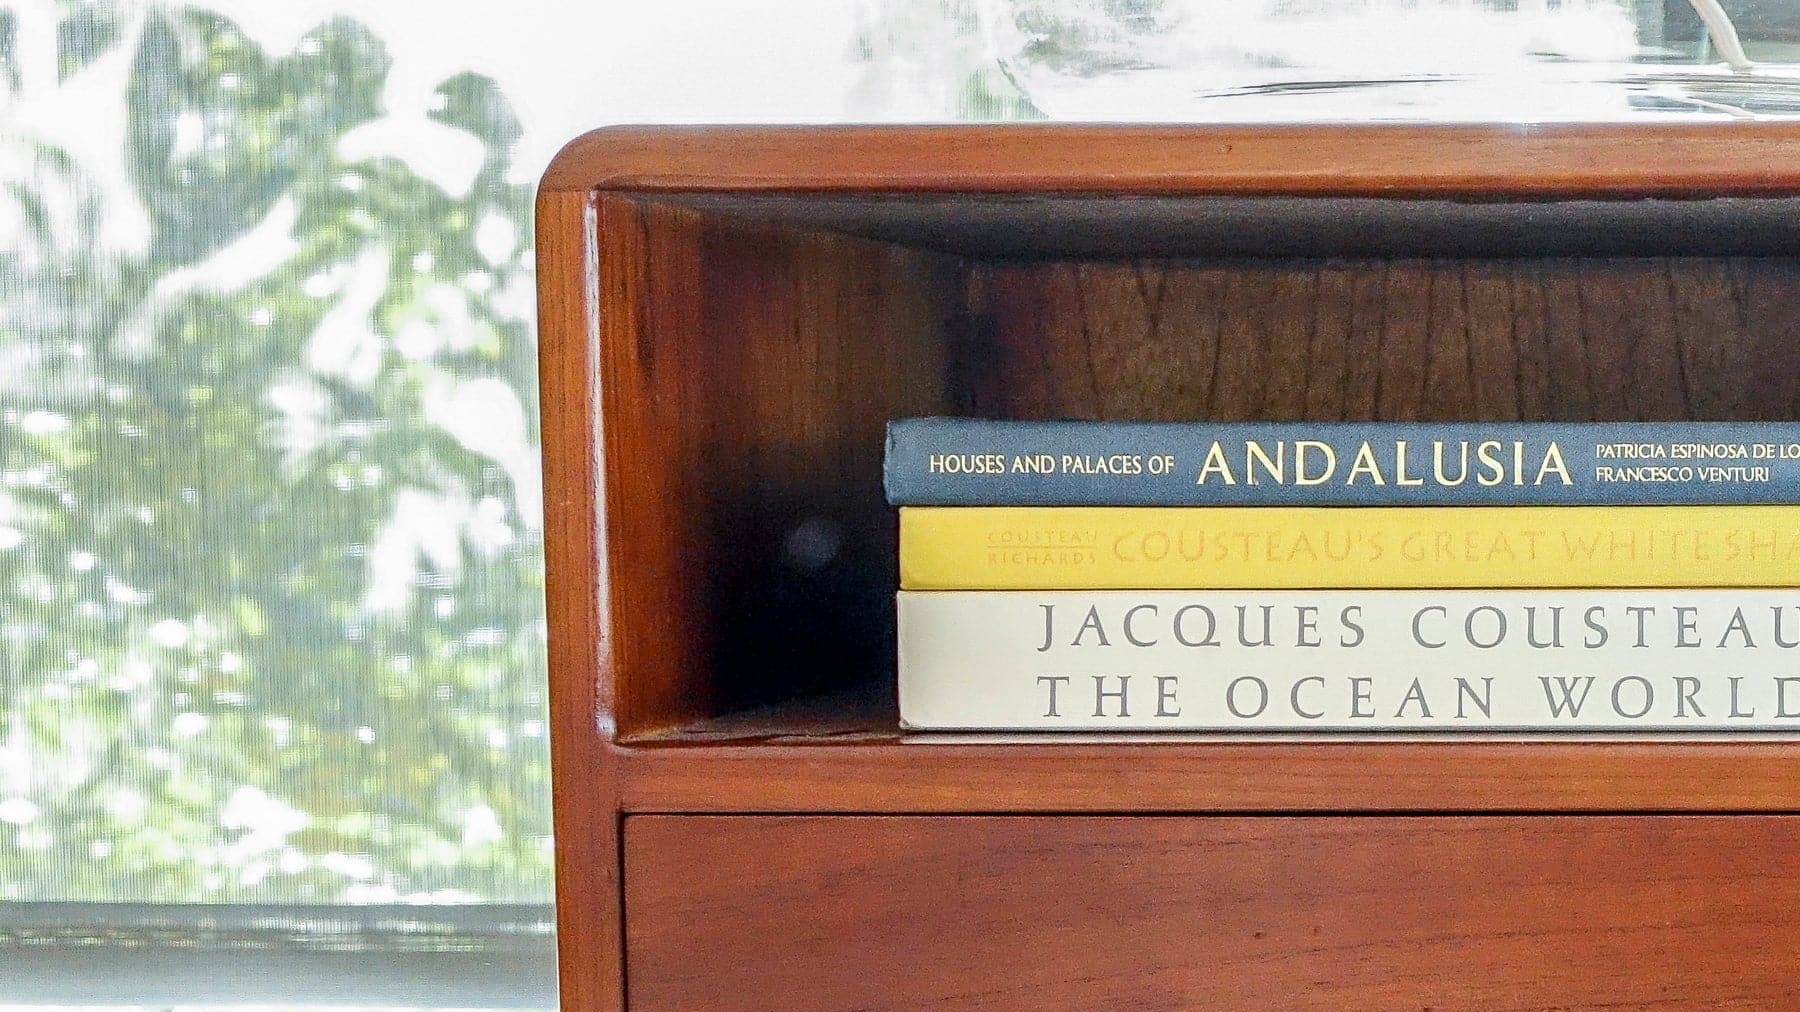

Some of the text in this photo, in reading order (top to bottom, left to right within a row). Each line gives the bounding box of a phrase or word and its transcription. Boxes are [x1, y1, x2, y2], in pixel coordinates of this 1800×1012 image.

[928, 440, 1574, 487] HOUSES AND PALACES OF ANDALUSIA
[1596, 444, 1666, 459] PATRICIA
[1671, 444, 1749, 459] ESPINOSA
[1752, 444, 1776, 459] DE
[1596, 467, 1770, 483] FRANCESCO VENTURI
[986, 529, 1098, 545] COUSTEAU
[1112, 529, 1385, 564] COUSTEAU'S
[1400, 528, 1547, 564] GREAT
[1561, 528, 1722, 564] WHITE
[986, 551, 1098, 566] RICHARDS
[1037, 604, 1366, 652] JACQUES
[1037, 675, 1183, 719] THE
[1225, 675, 1493, 719] OCEAN
